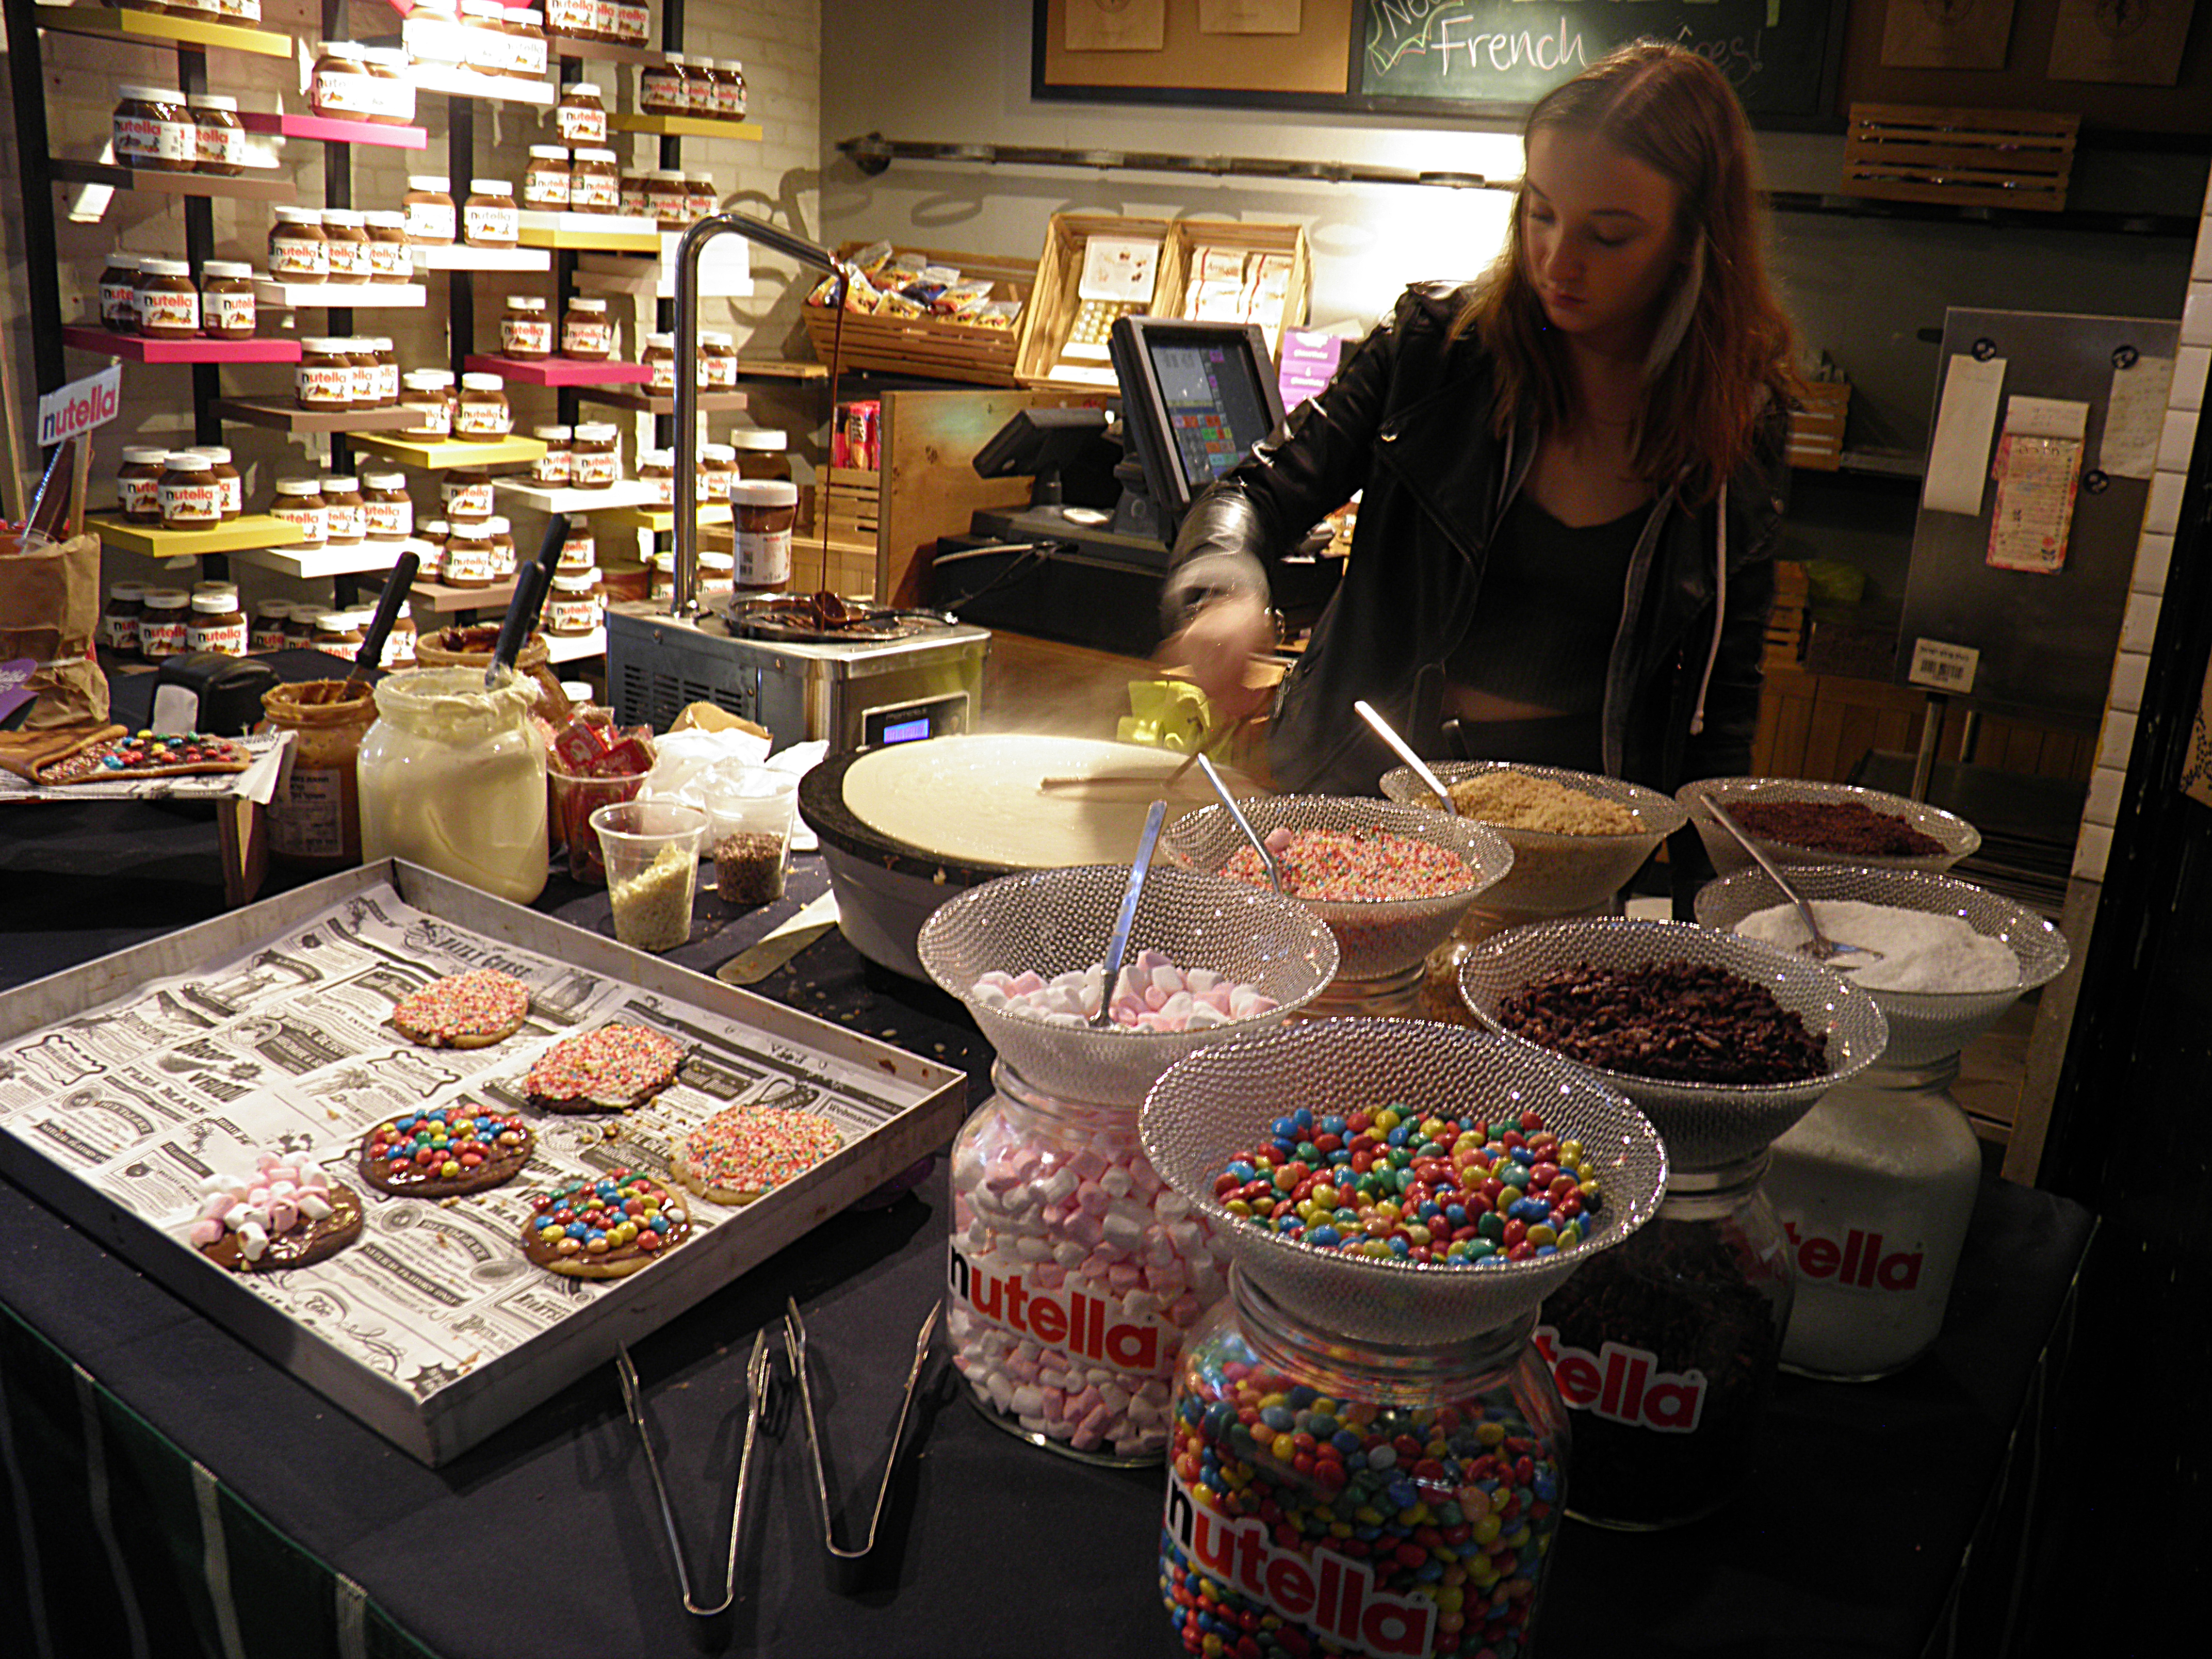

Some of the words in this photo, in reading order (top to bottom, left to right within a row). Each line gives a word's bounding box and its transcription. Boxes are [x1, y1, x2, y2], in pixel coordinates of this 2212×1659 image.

[1430, 14, 1589, 77] French
[566, 110, 603, 123] nutella
[196, 129, 229, 144] tella
[276, 247, 316, 258] nutella
[329, 247, 354, 259] tella
[371, 248, 396, 259] tella
[144, 295, 192, 308] nutella
[505, 324, 544, 336] nutella
[302, 369, 347, 383] nutella
[43, 384, 116, 441] nutella
[166, 486, 213, 500] nutella
[451, 486, 489, 498] nutella
[329, 512, 352, 522] tella
[365, 505, 400, 516] utella
[557, 605, 593, 615] nutella
[198, 628, 241, 642] nutella
[950, 1246, 1159, 1370] nutella
[1172, 1476, 1430, 1654] nutella
